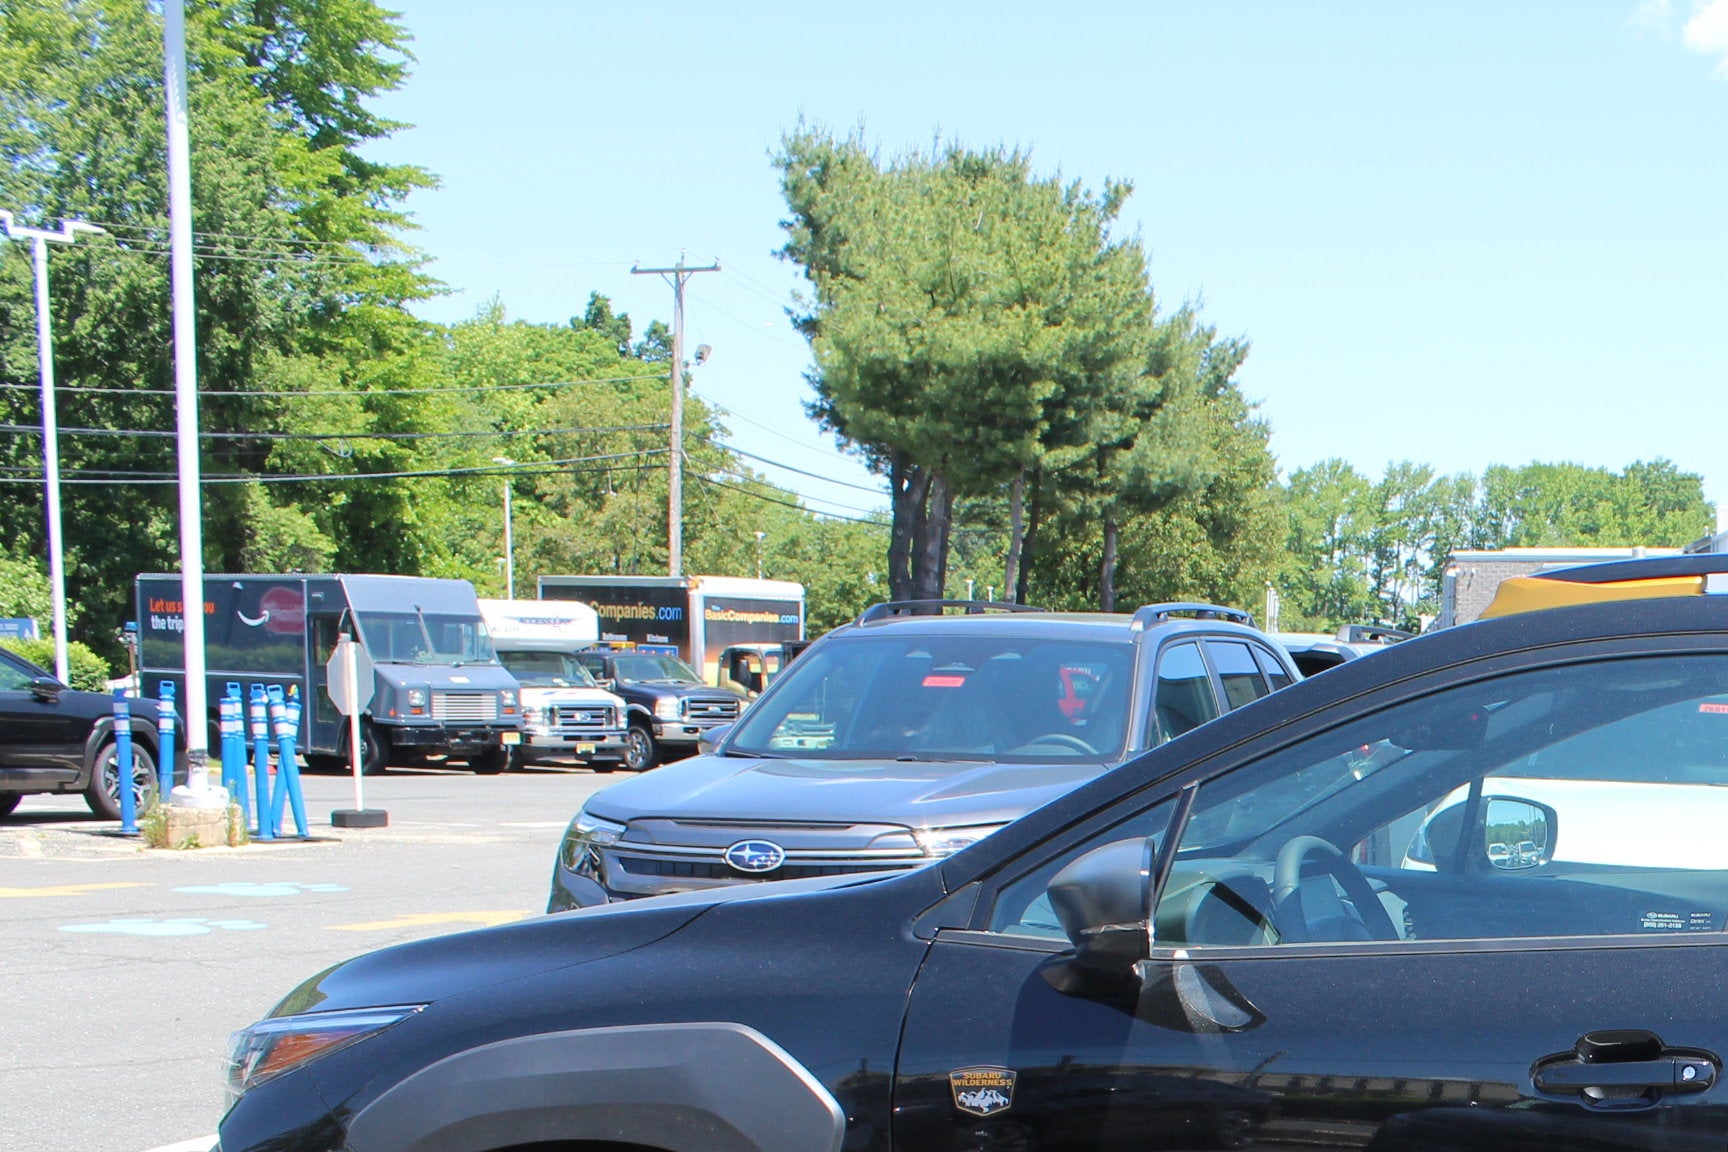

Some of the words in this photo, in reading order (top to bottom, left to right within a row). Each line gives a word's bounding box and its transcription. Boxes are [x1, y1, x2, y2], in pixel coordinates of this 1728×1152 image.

[150, 598, 164, 613] Let
[165, 602, 176, 613] us
[151, 614, 166, 630] the
[167, 616, 184, 633] trip
[705, 608, 799, 624] BasicCompanies.com
